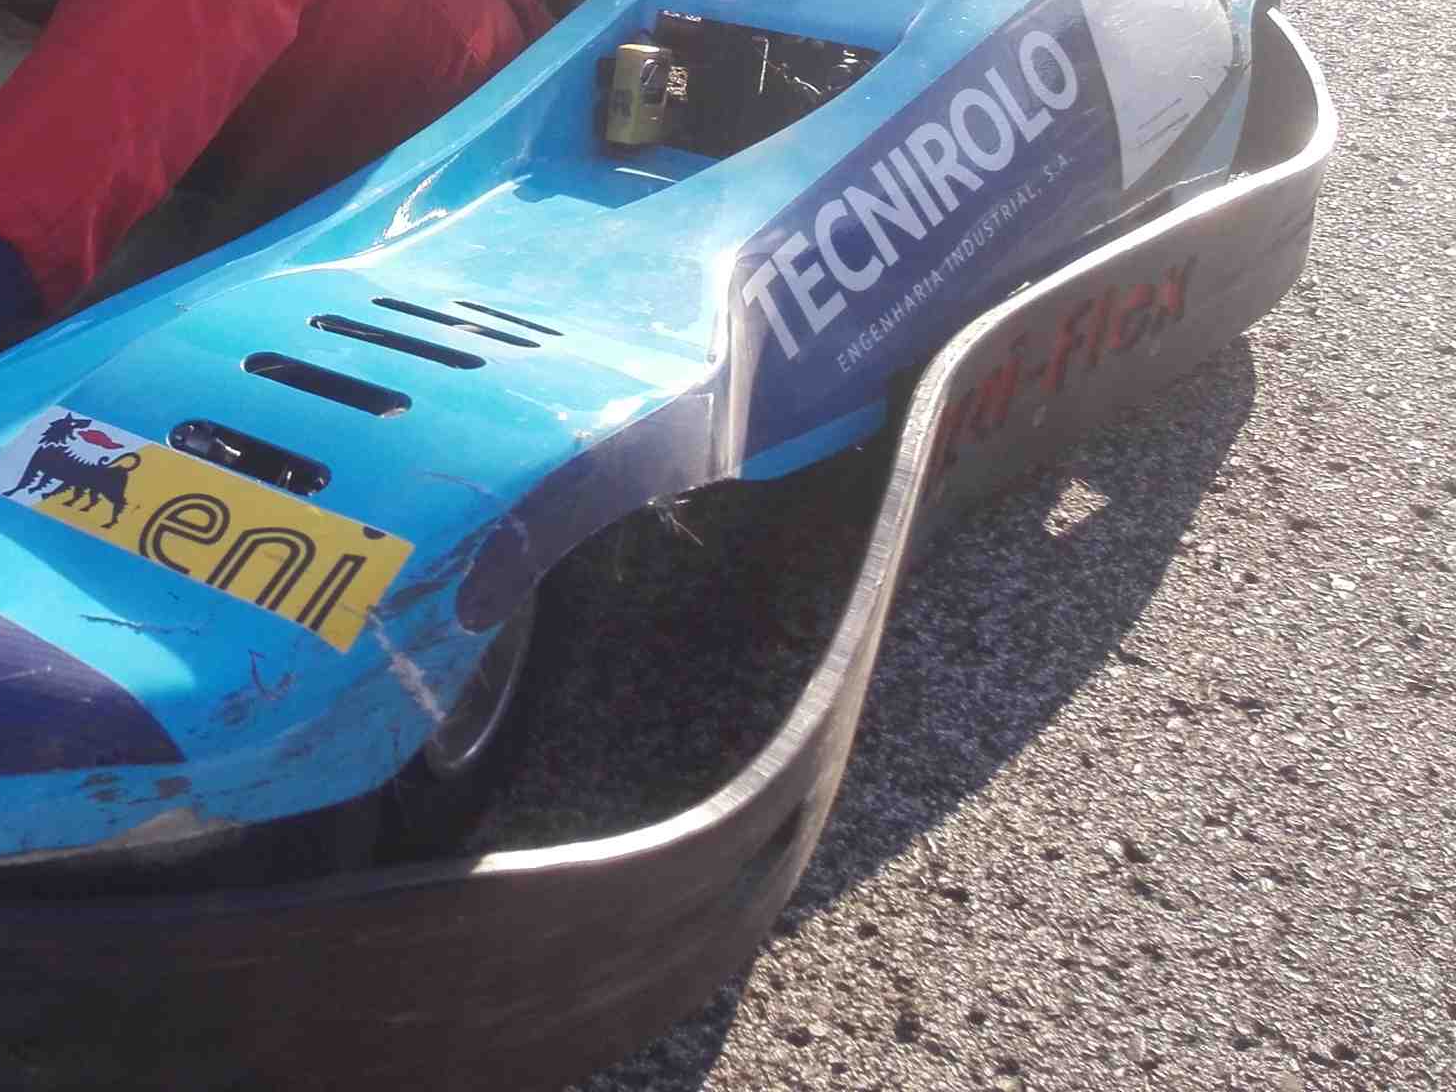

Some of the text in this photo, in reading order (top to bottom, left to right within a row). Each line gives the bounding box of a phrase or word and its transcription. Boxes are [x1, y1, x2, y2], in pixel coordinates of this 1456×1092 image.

[742, 30, 1079, 361] TECNIROLO
[837, 269, 944, 373] ENGENHARIA
[138, 493, 387, 631] eni
